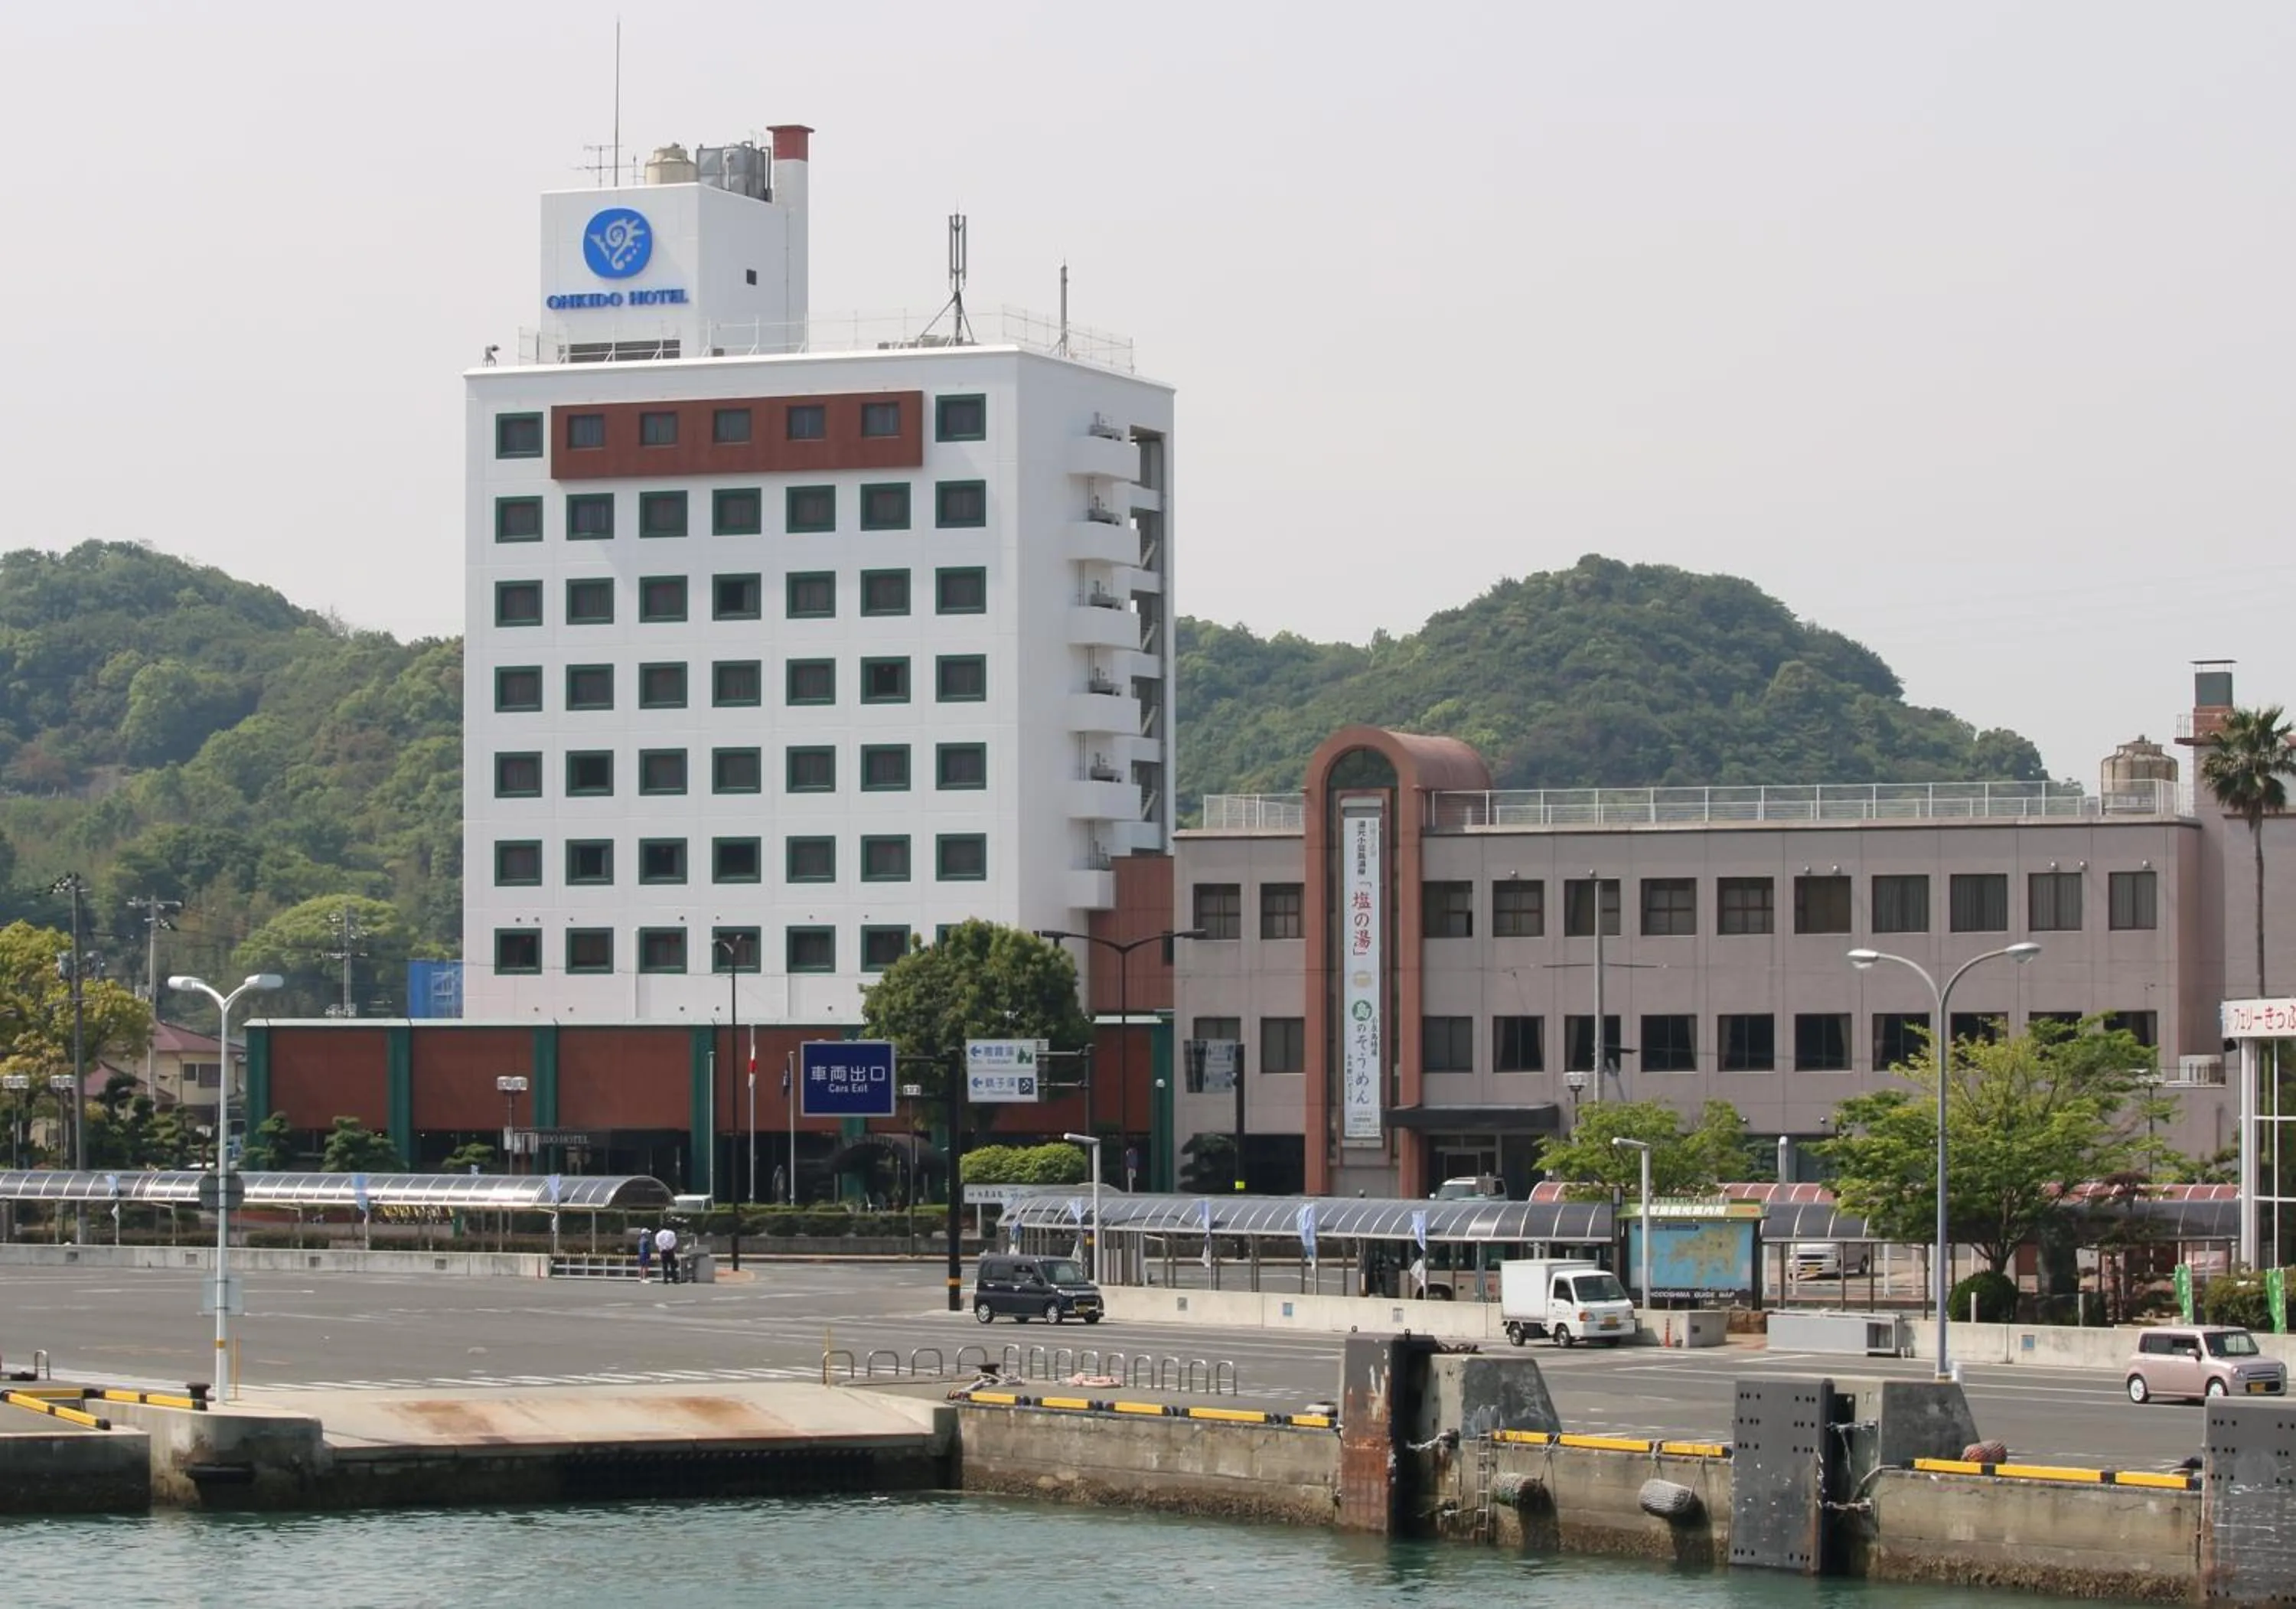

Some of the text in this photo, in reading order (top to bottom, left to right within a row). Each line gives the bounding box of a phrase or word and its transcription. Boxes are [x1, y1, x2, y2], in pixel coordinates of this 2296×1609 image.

[546, 289, 689, 310] OHKIDO HOTEL
[810, 1065, 885, 1082] 車両出口
[828, 1083, 868, 1093] Cars Exit
